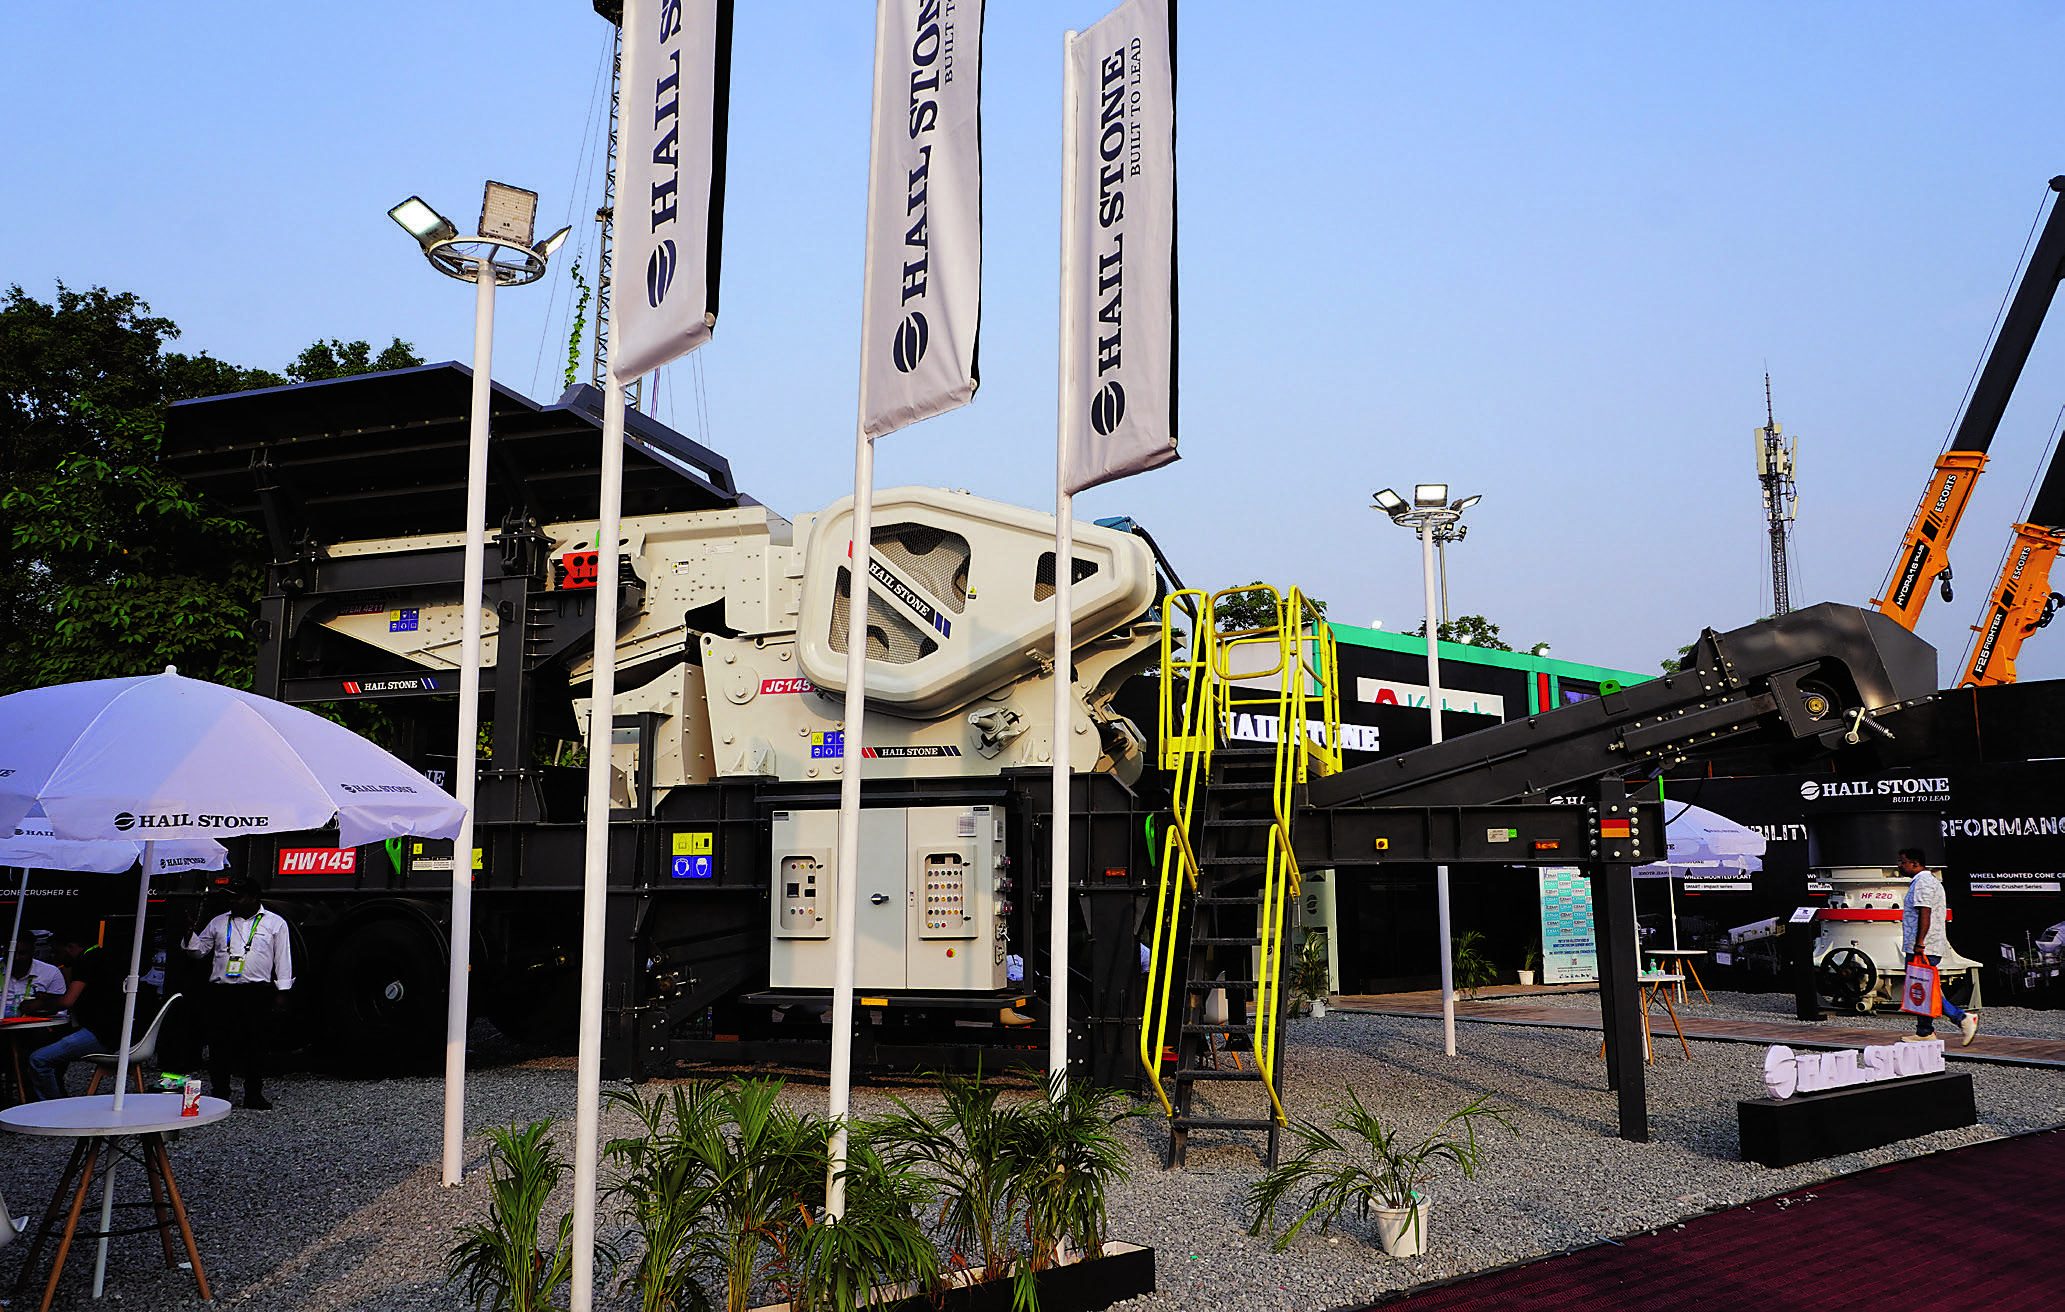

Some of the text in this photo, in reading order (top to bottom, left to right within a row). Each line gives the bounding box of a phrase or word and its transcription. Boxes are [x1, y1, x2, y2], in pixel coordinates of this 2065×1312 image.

[944, 24, 956, 85] BUILT
[1130, 36, 1141, 177] BUILT TO LEAD
[650, 48, 681, 235] HAIL
[901, 144, 932, 307] HAIL
[1098, 46, 1126, 378] HAIL STONE
[1934, 474, 1957, 513] ESCORTS
[2011, 546, 2031, 580] ESCORTS
[869, 562, 930, 617] HAIL STONE
[364, 680, 418, 691] HAIL STONE
[765, 680, 811, 693] JC145
[881, 747, 938, 756] HAIL STONE
[1821, 777, 1950, 797] HAIL STONE
[1892, 796, 1915, 804] BUILT
[1929, 794, 1951, 803] LEAD
[138, 814, 269, 829] HAIL STONE
[282, 851, 355, 871] HW145
